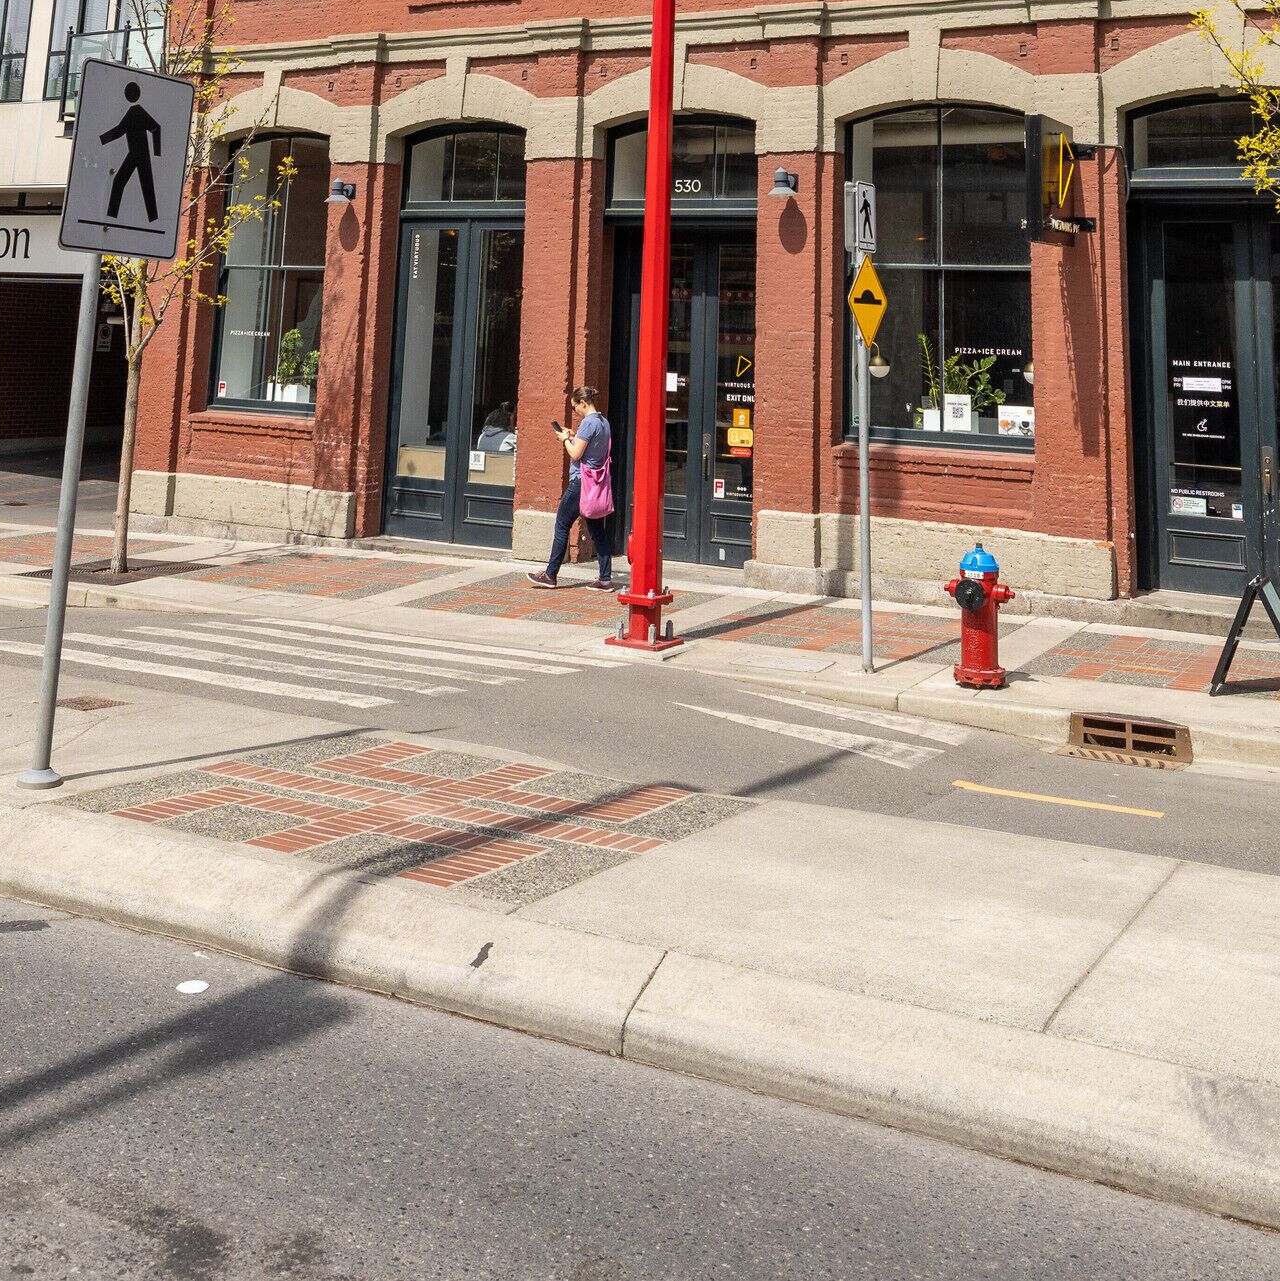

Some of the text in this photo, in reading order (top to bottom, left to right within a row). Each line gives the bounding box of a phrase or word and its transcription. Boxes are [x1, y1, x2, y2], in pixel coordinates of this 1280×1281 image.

[674, 179, 701, 193] 530
[996, 348, 1022, 356] CREAM
[1193, 360, 1231, 369] ENTRANCE
[726, 394, 755, 403] EXIT ONL
[1195, 490, 1225, 498] RESTROOMS
